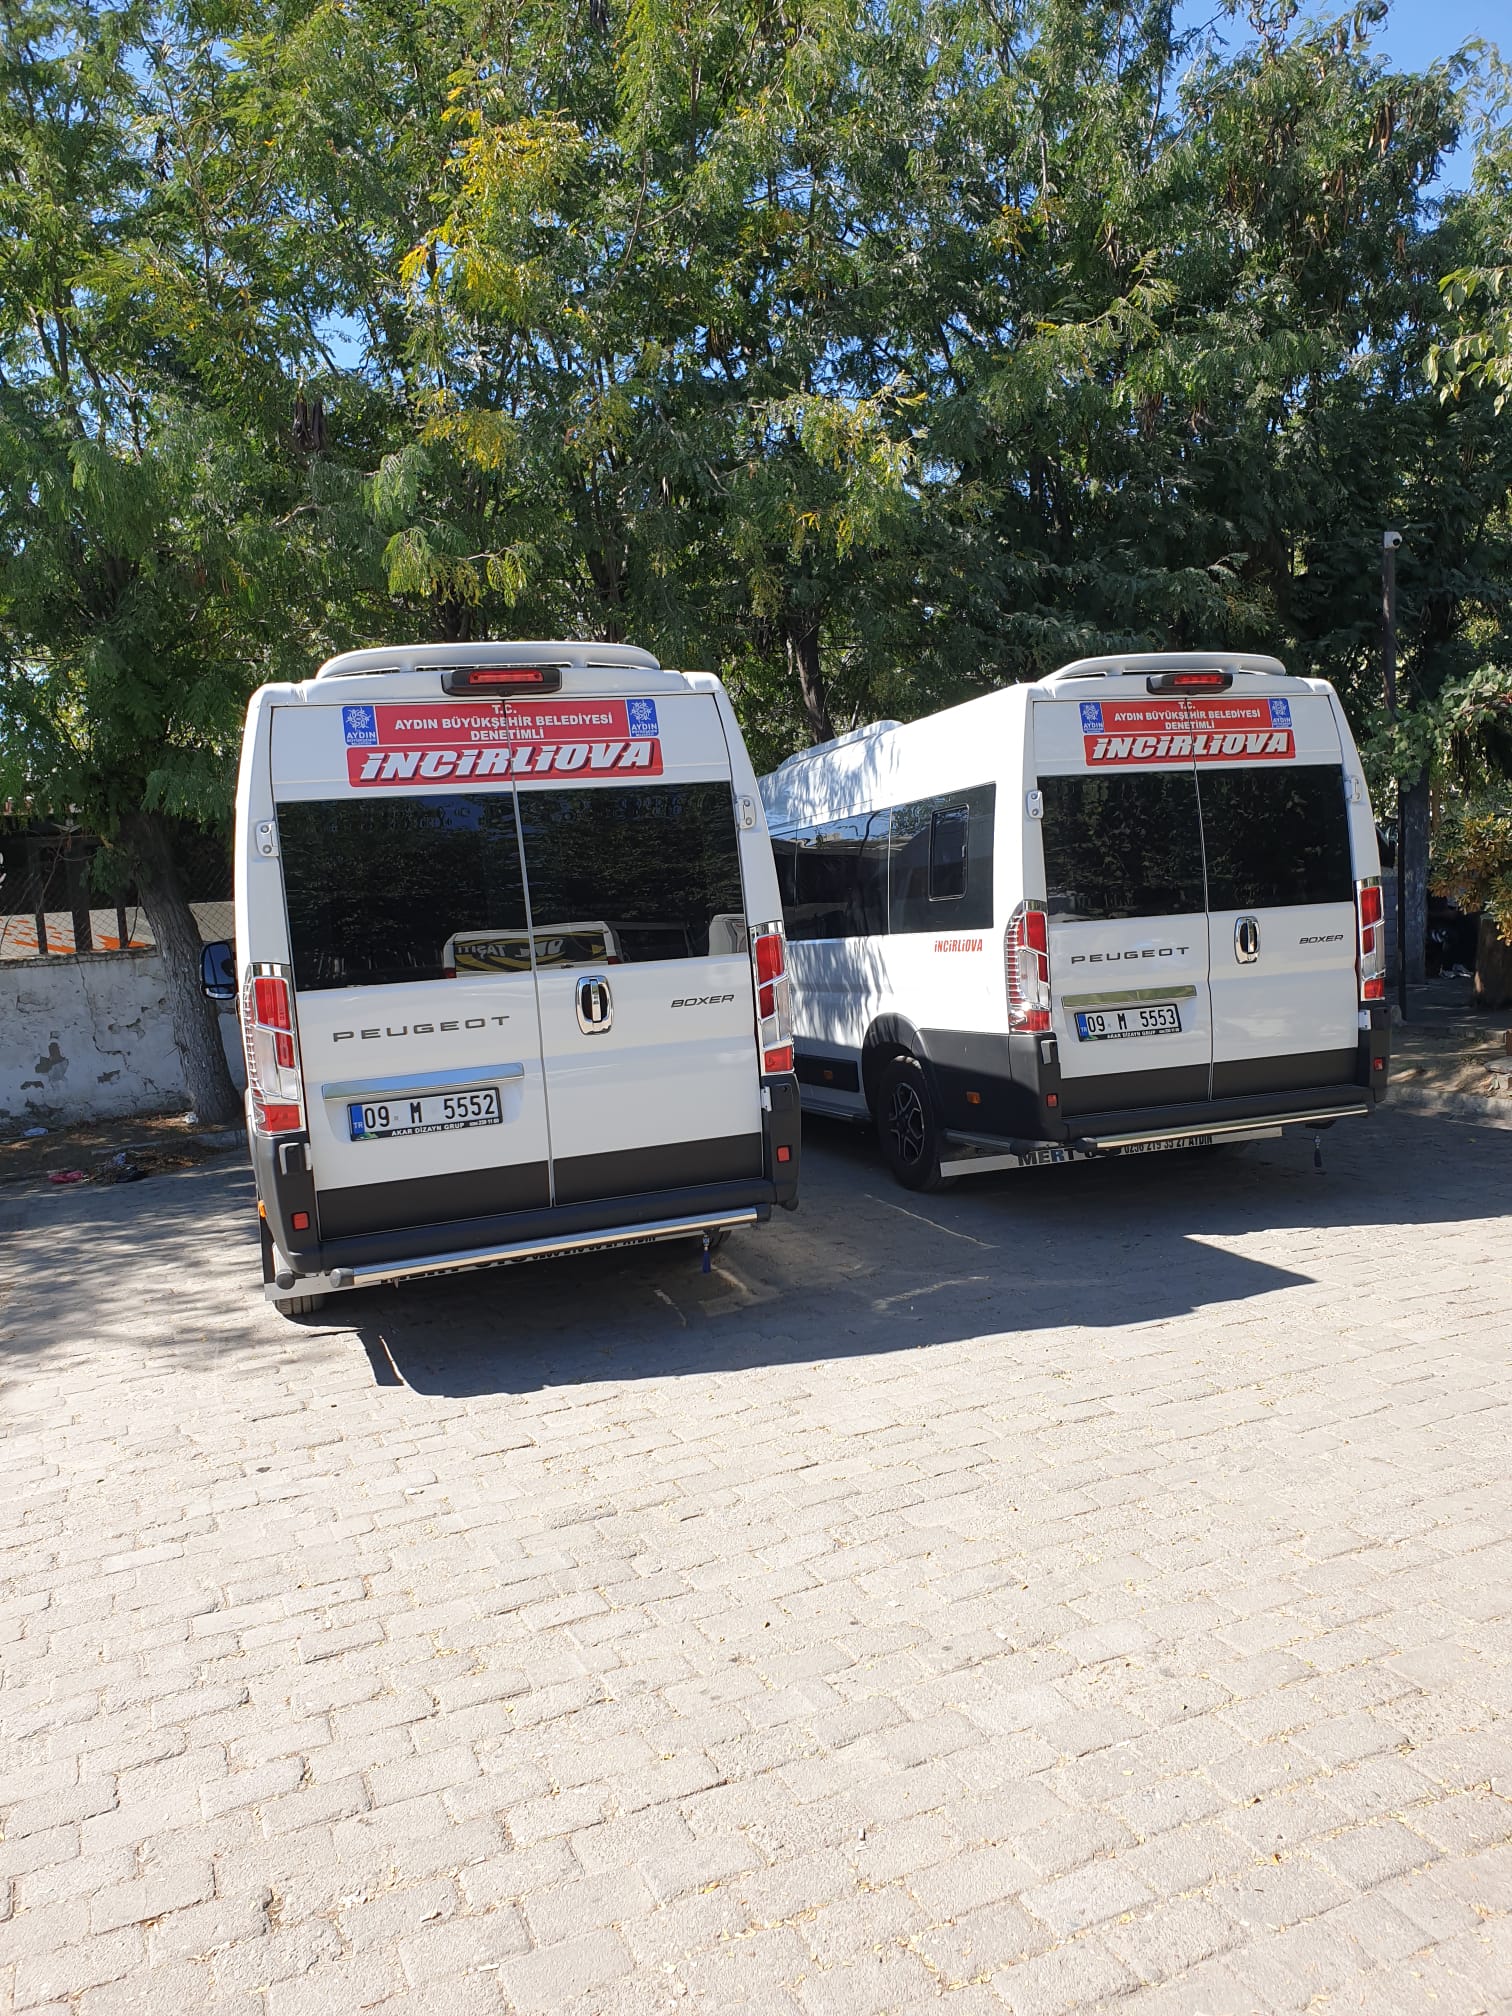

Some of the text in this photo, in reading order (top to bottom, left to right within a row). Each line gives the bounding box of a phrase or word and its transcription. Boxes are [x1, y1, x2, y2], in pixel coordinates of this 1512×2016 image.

[492, 704, 517, 714] T.C.
[1114, 708, 1260, 721] AYDIN BÜYÜKŞEHİR BELEDİYESİ
[395, 712, 613, 730] AYDIN BÜYÜKŞEHİR BELEDİYESİ
[632, 723, 657, 731] AYDIN
[1165, 719, 1215, 730] DENETİMLİ
[346, 731, 376, 739] AYDIN
[470, 727, 545, 741] DENETİMLİ
[1299, 934, 1344, 945] BOXER
[1071, 946, 1190, 965] PEUGEOT
[671, 994, 735, 1008] BOXER
[1087, 1009, 1176, 1033] 09 M 5553
[333, 1015, 510, 1043] PEUGEOT
[364, 1093, 496, 1129] 09 M 5552
[353, 1121, 363, 1129] TR
[391, 1128, 413, 1137] AKAR
[414, 1125, 442, 1135] DİZAYN
[443, 1122, 465, 1131] GRUP
[1018, 1148, 1074, 1167] MERT
